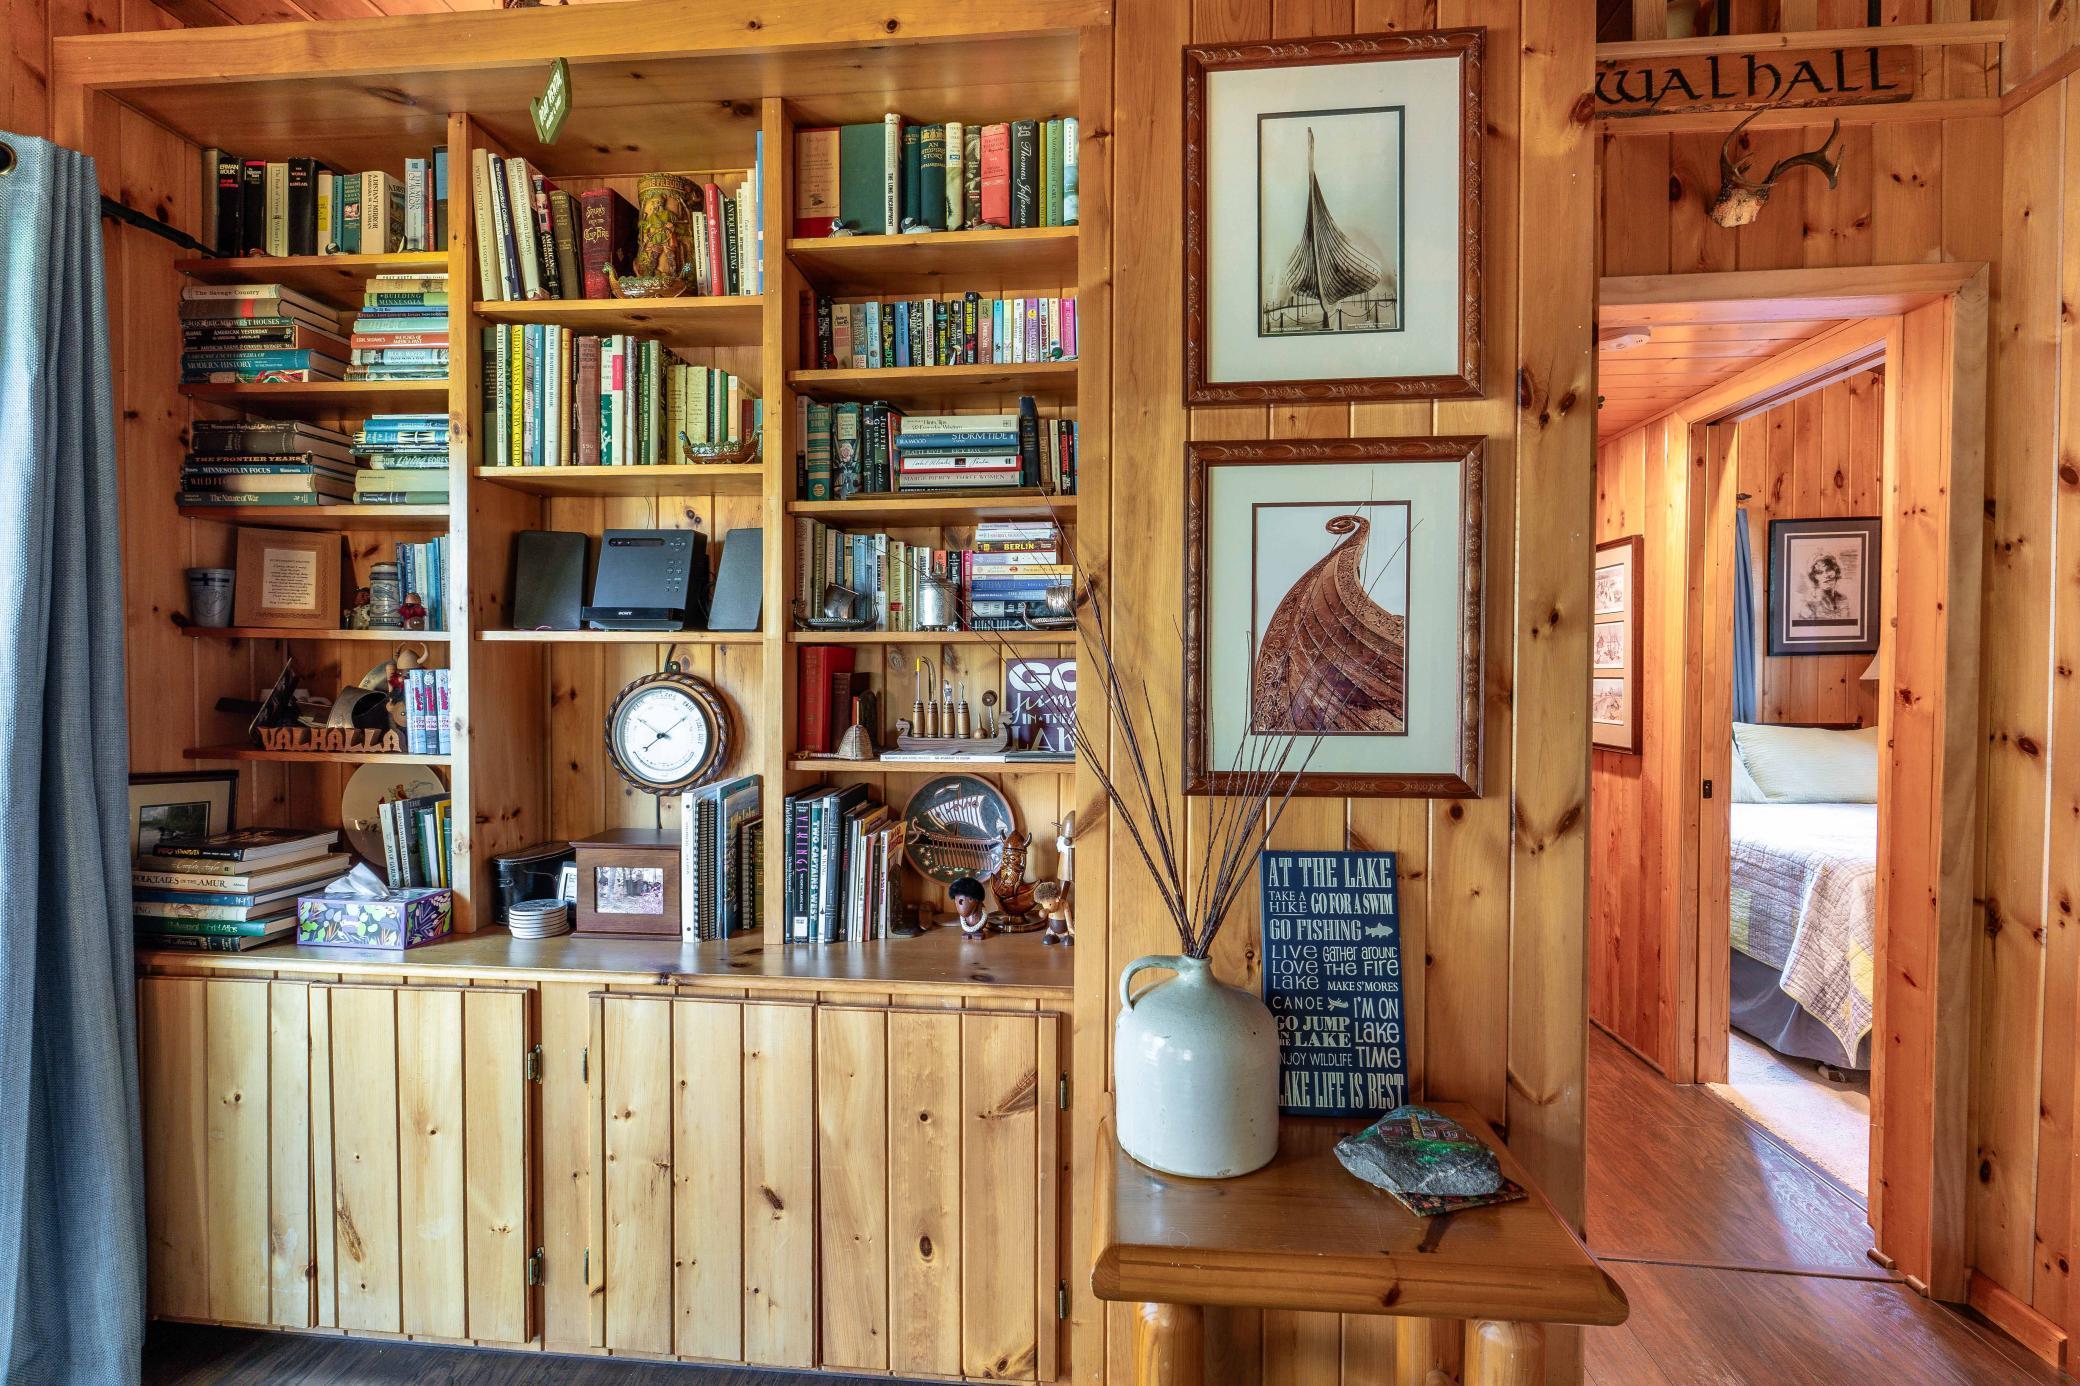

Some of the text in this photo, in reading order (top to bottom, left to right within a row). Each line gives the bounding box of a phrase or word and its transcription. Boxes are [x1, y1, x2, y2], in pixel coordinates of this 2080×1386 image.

[1016, 141, 1032, 224] Thomas Jefferson
[516, 161, 524, 193] Milestones
[521, 202, 529, 230] American
[728, 203, 736, 234] ANTIQUE
[546, 234, 555, 267] AMERICAN
[1008, 662, 1076, 692] GO
[1022, 714, 1068, 724] IN THE
[258, 728, 400, 751] VALHALLA
[1011, 726, 1076, 752] LAK
[795, 816, 808, 872] VIKINGS
[390, 861, 398, 888] GARDENIN
[811, 846, 819, 890] CAPTAINS
[1269, 858, 1391, 888] AT THE LAKE
[196, 880, 227, 888] AMUR
[1269, 891, 1306, 901] TAKE A
[1311, 893, 1394, 915] GO FOR A SWIM
[1270, 902, 1308, 913] HIKE
[1270, 919, 1361, 941] GO FISHING
[1327, 982, 1398, 992] MAKE S'MORES
[1272, 997, 1324, 1010] CANOE
[1354, 998, 1399, 1020] I'M ON
[1274, 1016, 1350, 1032] GO JUMP
[1294, 1032, 1351, 1048] LAKE
[1280, 1053, 1352, 1067] NJOY WILDLIFE
[1314, 1072, 1345, 1108] LIFE
[1350, 1073, 1363, 1108] IS
[1368, 1073, 1404, 1109] BEST
